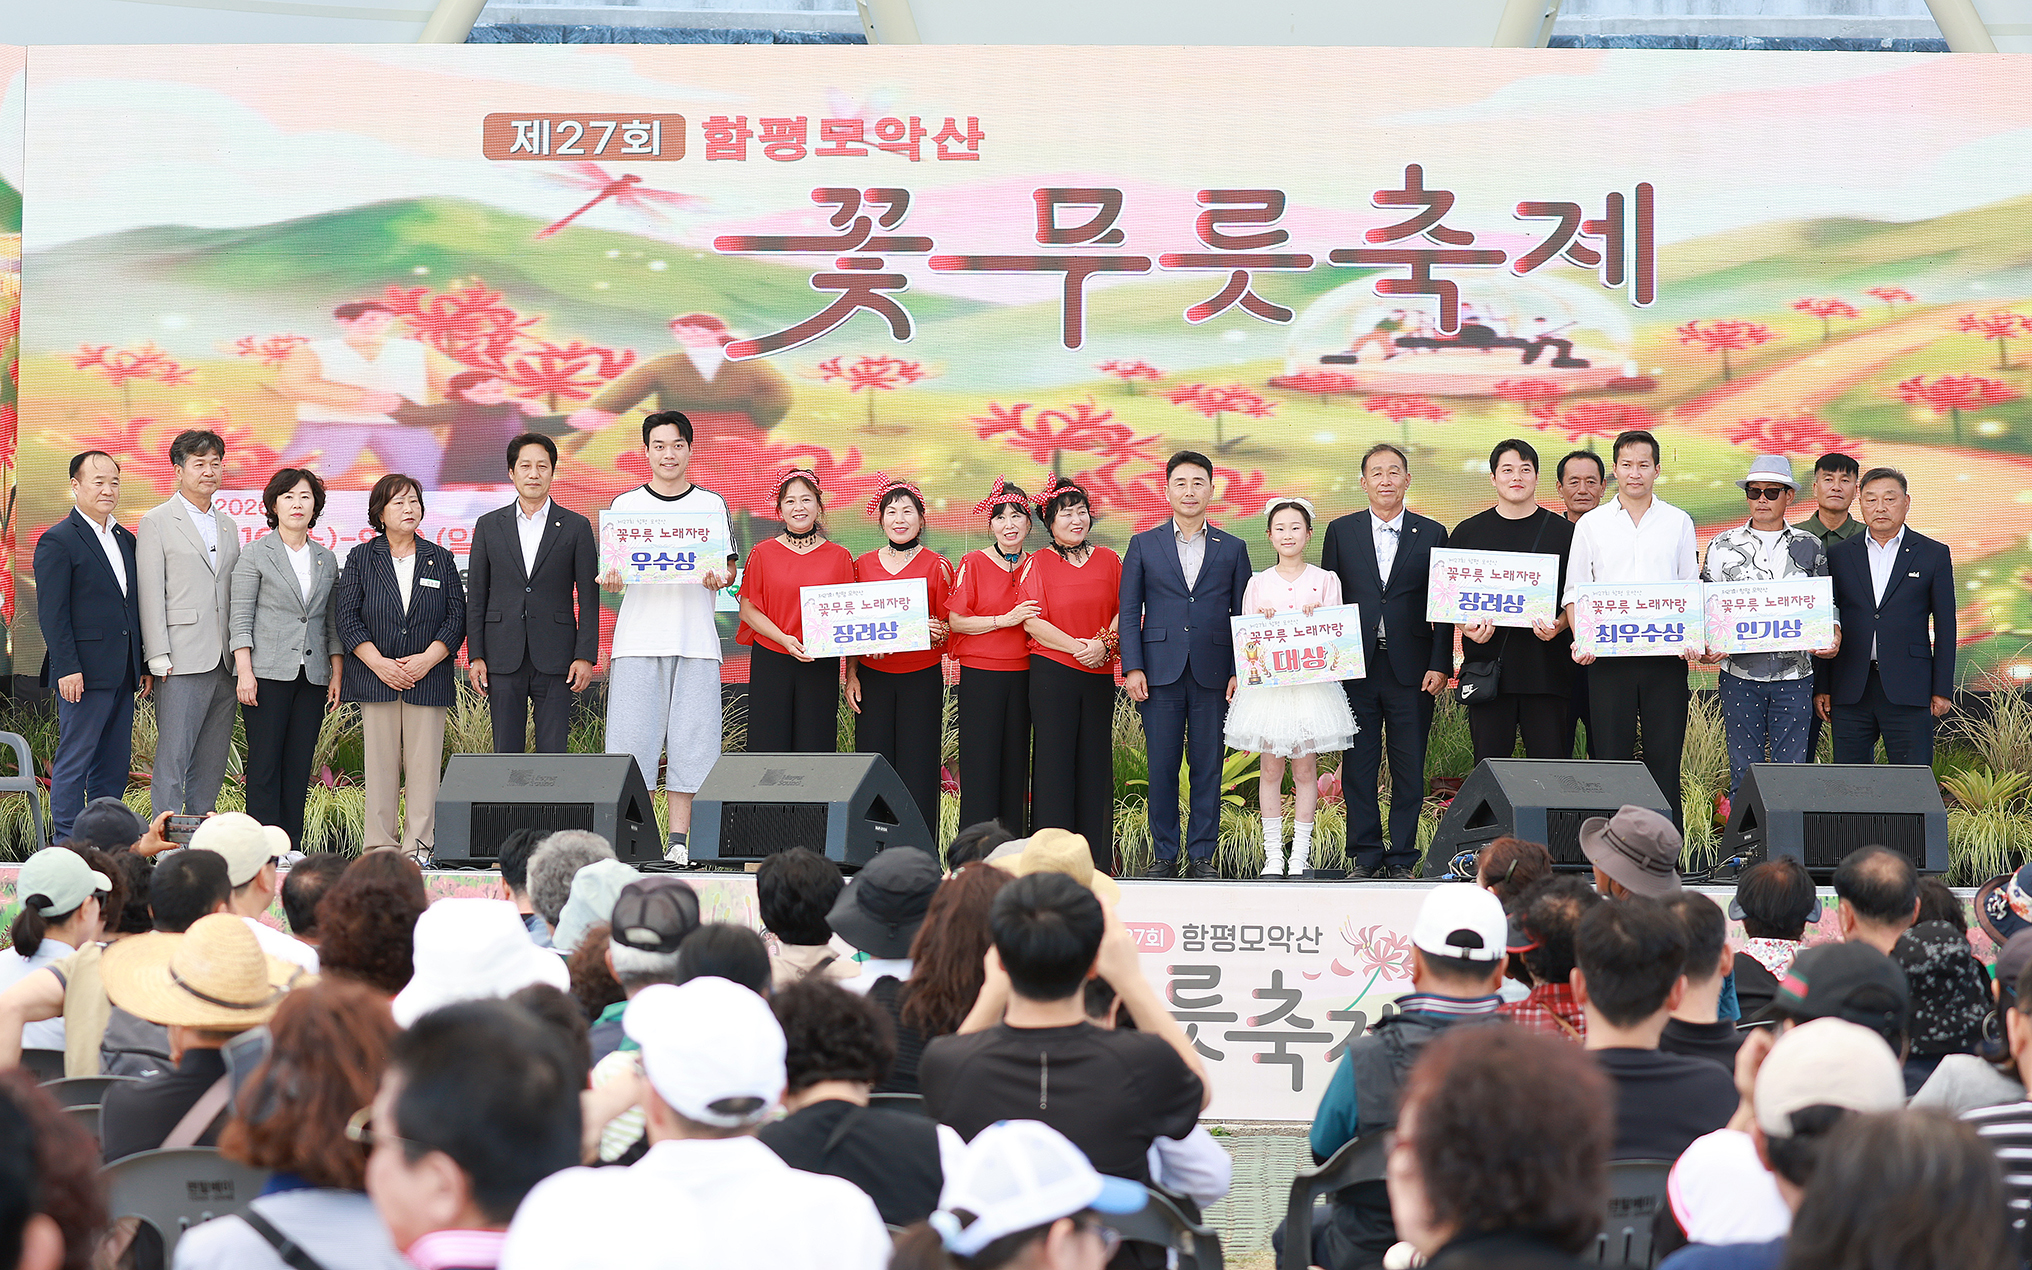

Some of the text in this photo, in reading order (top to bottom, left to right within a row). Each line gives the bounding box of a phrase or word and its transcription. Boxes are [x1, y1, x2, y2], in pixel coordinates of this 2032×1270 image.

[510, 115, 985, 163] 제27회 함평모악산
[713, 163, 1656, 360] 꽃무릇축제
[616, 527, 710, 543] 꽃무릇 노래자랑
[631, 552, 697, 571] 우수상
[1447, 566, 1541, 586] 꽃무릇 노래자랑
[818, 596, 911, 617] 꽃무릇 노래자랑
[1459, 591, 1526, 614] 장려상
[1592, 598, 1687, 615] 꽃무릇 노래자랑
[1721, 595, 1816, 614] 꽃무릇 노래자랑
[833, 621, 899, 644] 장려상
[1250, 622, 1344, 646] 꽃무릇 노래자랑
[1595, 622, 1686, 643] 최우수상
[1736, 619, 1803, 640] 인기상
[1272, 645, 1328, 672] 대상
[1182, 923, 1323, 953] 함평모악산
